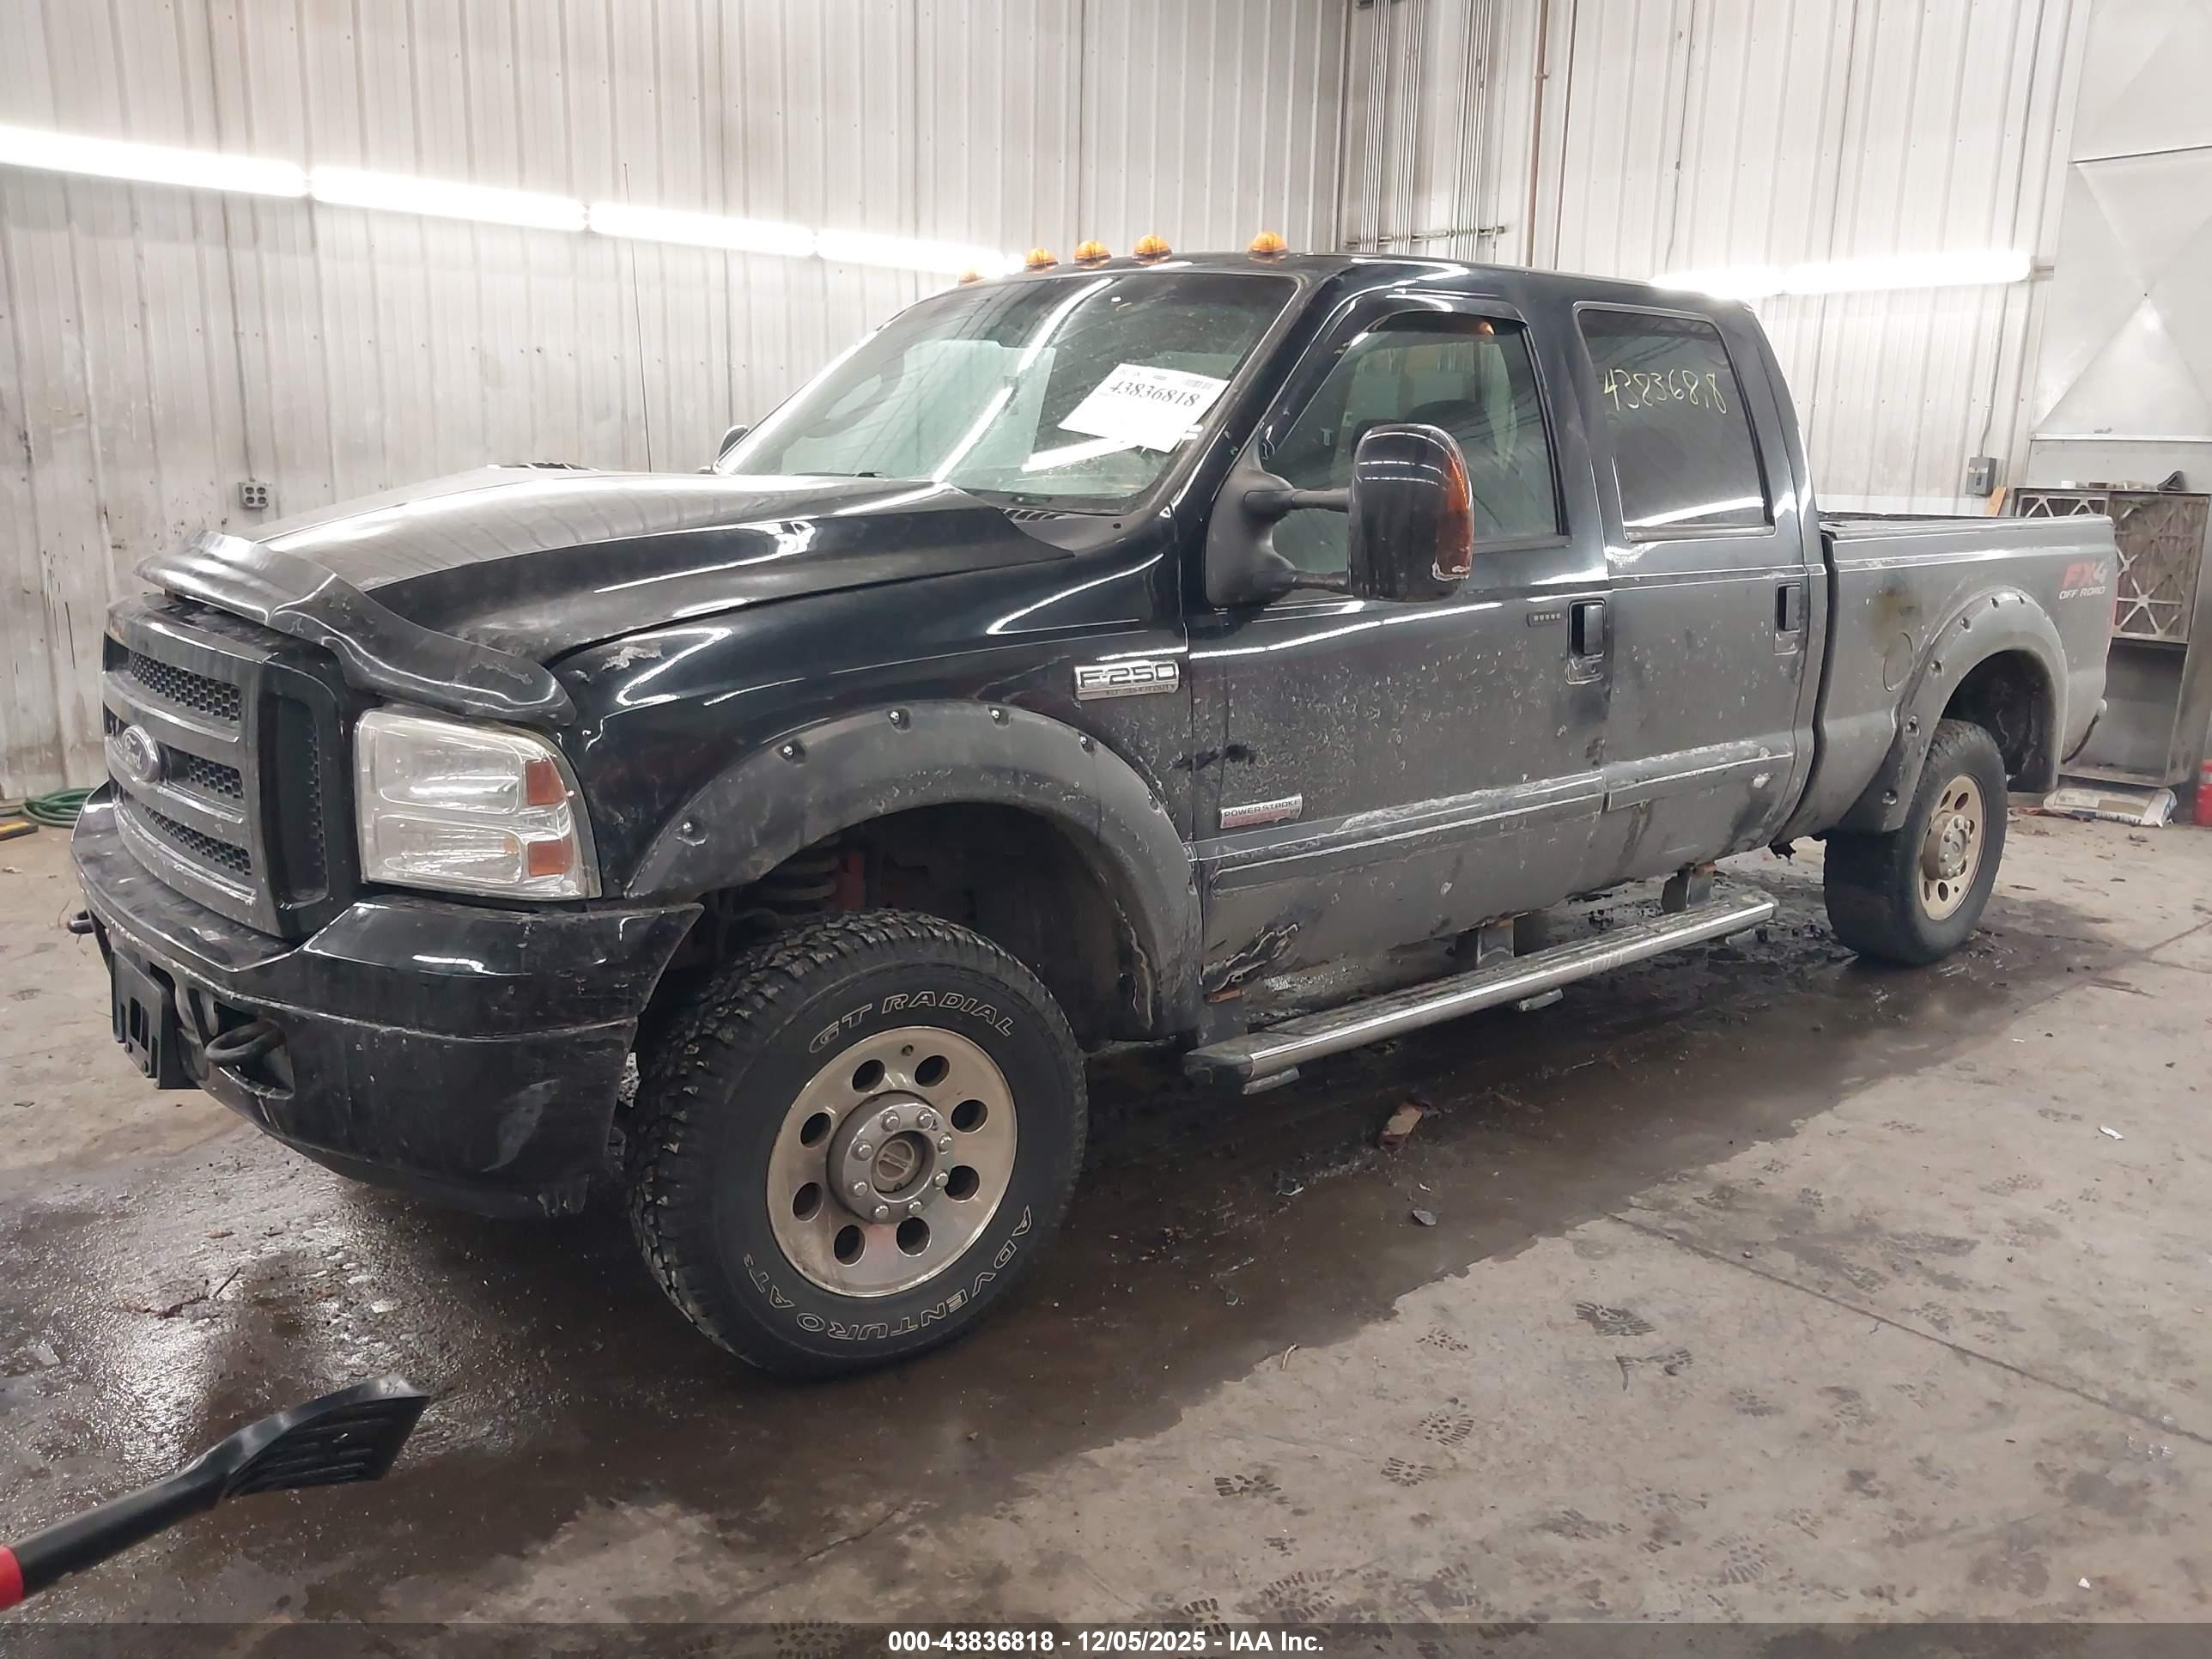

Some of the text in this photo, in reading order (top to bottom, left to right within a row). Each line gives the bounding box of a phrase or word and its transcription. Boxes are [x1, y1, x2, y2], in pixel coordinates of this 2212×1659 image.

[1109, 380, 1201, 407] 43836818
[2063, 562, 2108, 586] FX4
[2058, 586, 2106, 600] OFF ROAD
[1079, 663, 1177, 689] F-250
[809, 990, 1015, 1054] GT RADIAL
[796, 1204, 1032, 1341] ADVENTURO
